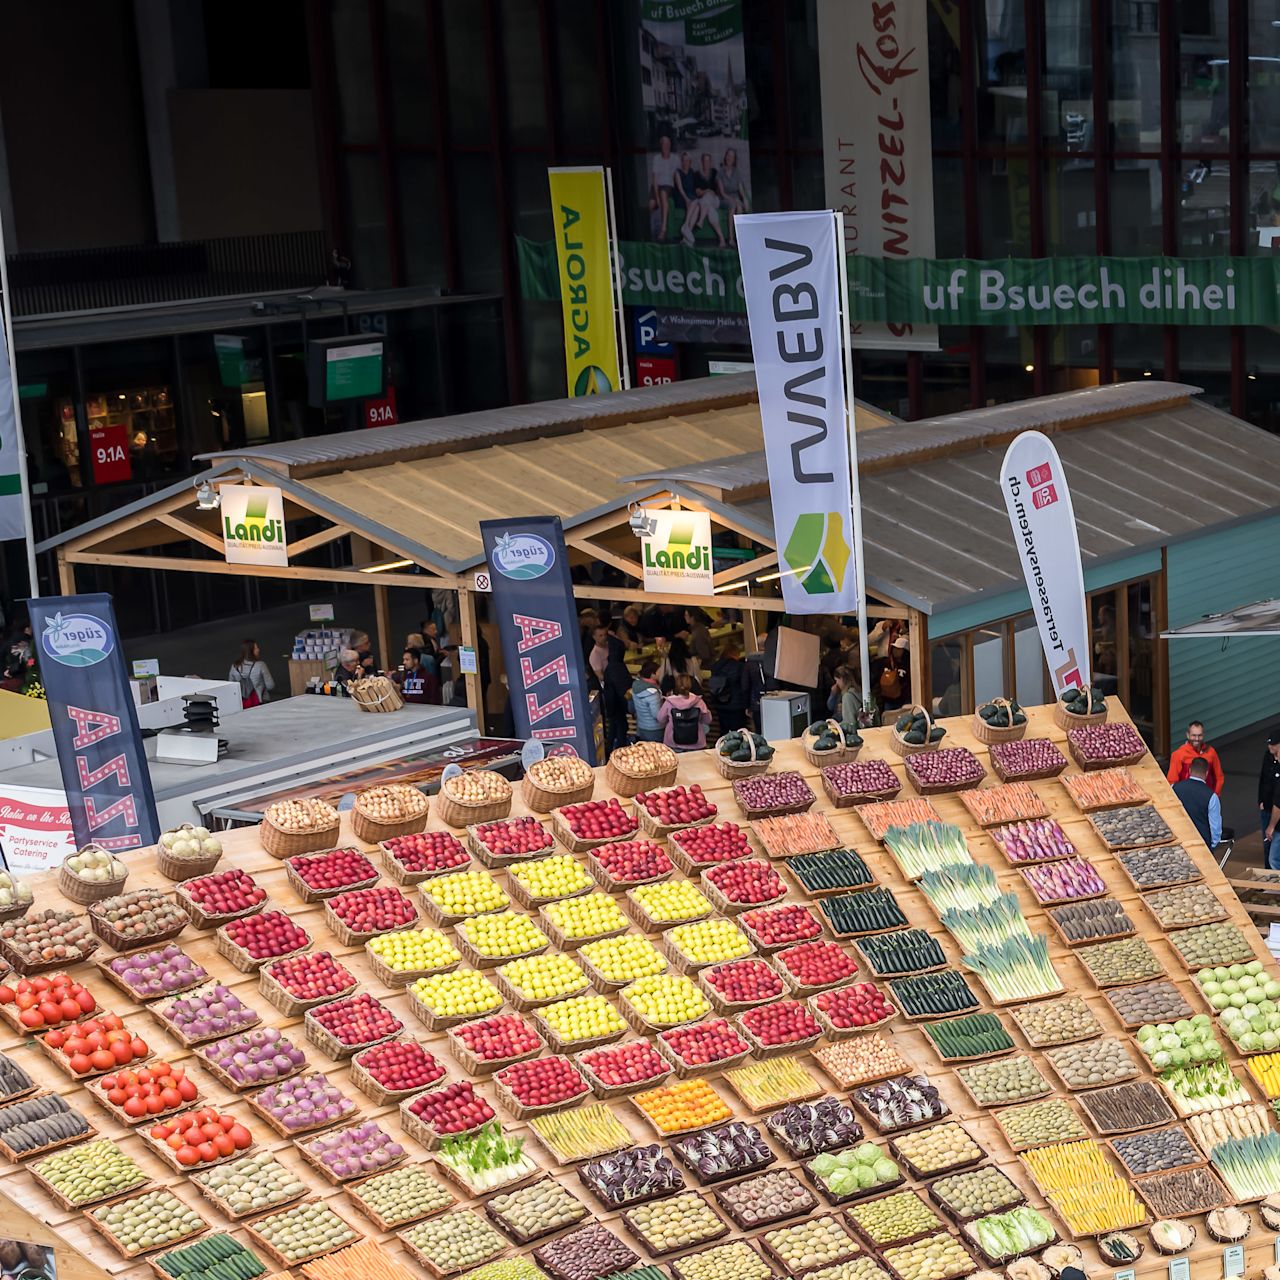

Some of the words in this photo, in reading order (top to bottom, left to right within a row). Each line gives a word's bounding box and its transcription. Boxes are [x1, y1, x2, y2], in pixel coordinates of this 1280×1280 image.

[923, 269, 967, 310] uf
[979, 267, 1125, 311] Bsuech
[1140, 267, 1235, 310] dihei
[643, 376, 672, 387] 91B
[369, 405, 393, 422] 9.1A
[96, 445, 125, 463] 9.1A
[225, 516, 283, 543] Landi
[645, 543, 710, 571] Landi
[56, 812, 72, 825] Ro
[9, 836, 58, 848] Partyservice
[13, 848, 48, 859] Catering
